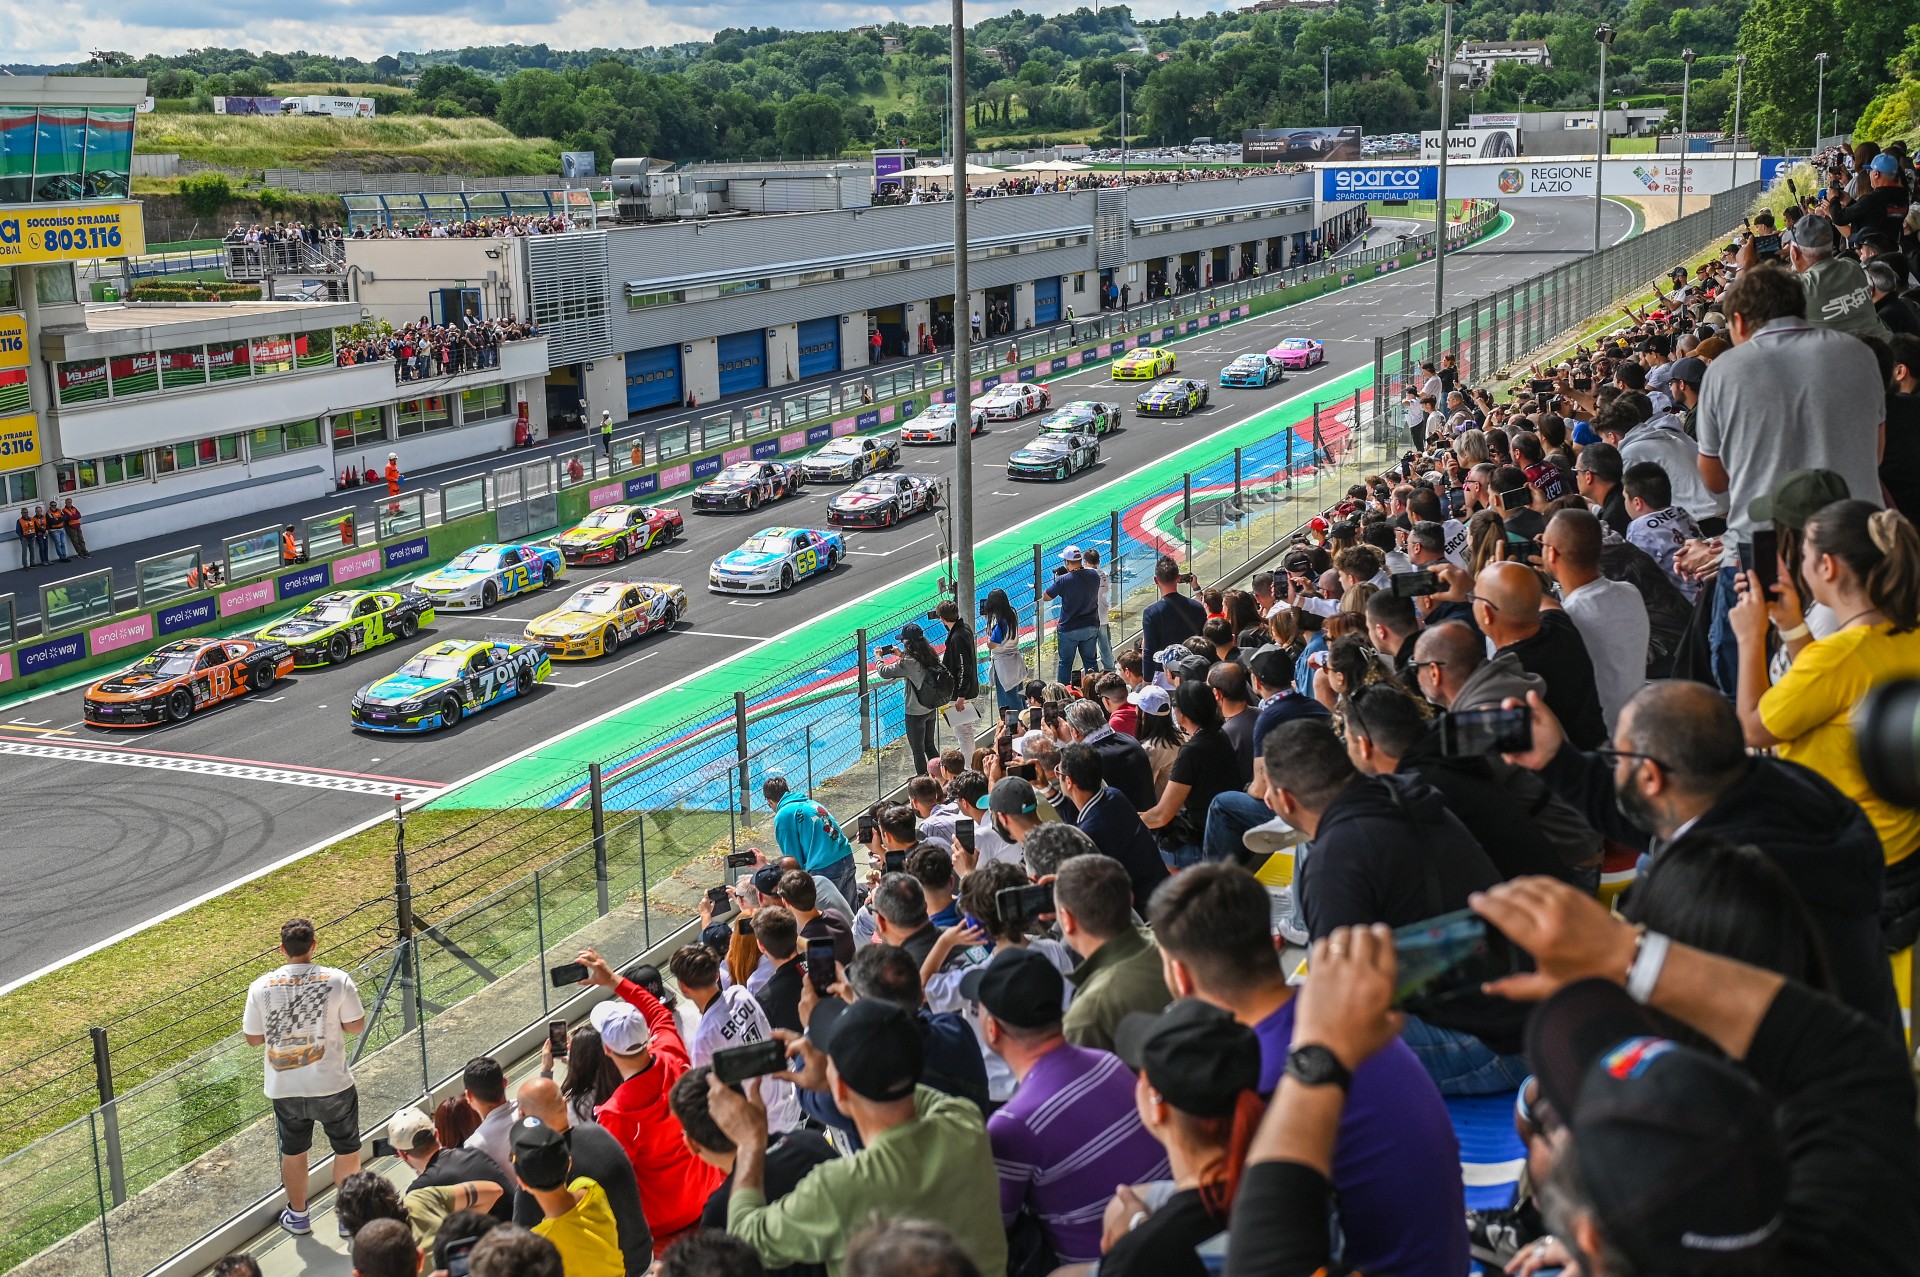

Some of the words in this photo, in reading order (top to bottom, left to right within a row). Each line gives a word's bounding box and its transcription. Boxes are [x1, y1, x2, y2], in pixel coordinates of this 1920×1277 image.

[1425, 137, 1476, 148] KUMHO
[1336, 169, 1420, 191] sparco
[1531, 167, 1592, 180] REGIONE
[1336, 192, 1419, 200] SPARCO-OFFICIAL.COM
[1531, 182, 1572, 193] LAZIO
[27, 216, 74, 228] SOCCORSO
[77, 214, 120, 225] STRADALE
[44, 226, 121, 251] 803.116
[4, 431, 32, 440] STRADALE
[1647, 508, 1677, 528] ONE
[636, 524, 651, 548] 3
[390, 548, 404, 560] enel
[410, 544, 424, 555] way
[339, 562, 354, 574] enel
[361, 557, 375, 568] way
[796, 550, 816, 575] 69
[285, 578, 301, 590] enel
[309, 572, 324, 584] way
[503, 566, 529, 592] 72
[227, 593, 245, 607] enel
[252, 587, 268, 600] way
[165, 608, 184, 625] enel
[192, 605, 209, 618] way
[634, 606, 649, 635] 5
[98, 628, 118, 644] enel
[128, 624, 145, 640] way
[26, 652, 48, 665] enel
[58, 642, 77, 655] way
[496, 648, 539, 683] orion
[207, 666, 230, 700] 13
[479, 673, 494, 701] 7
